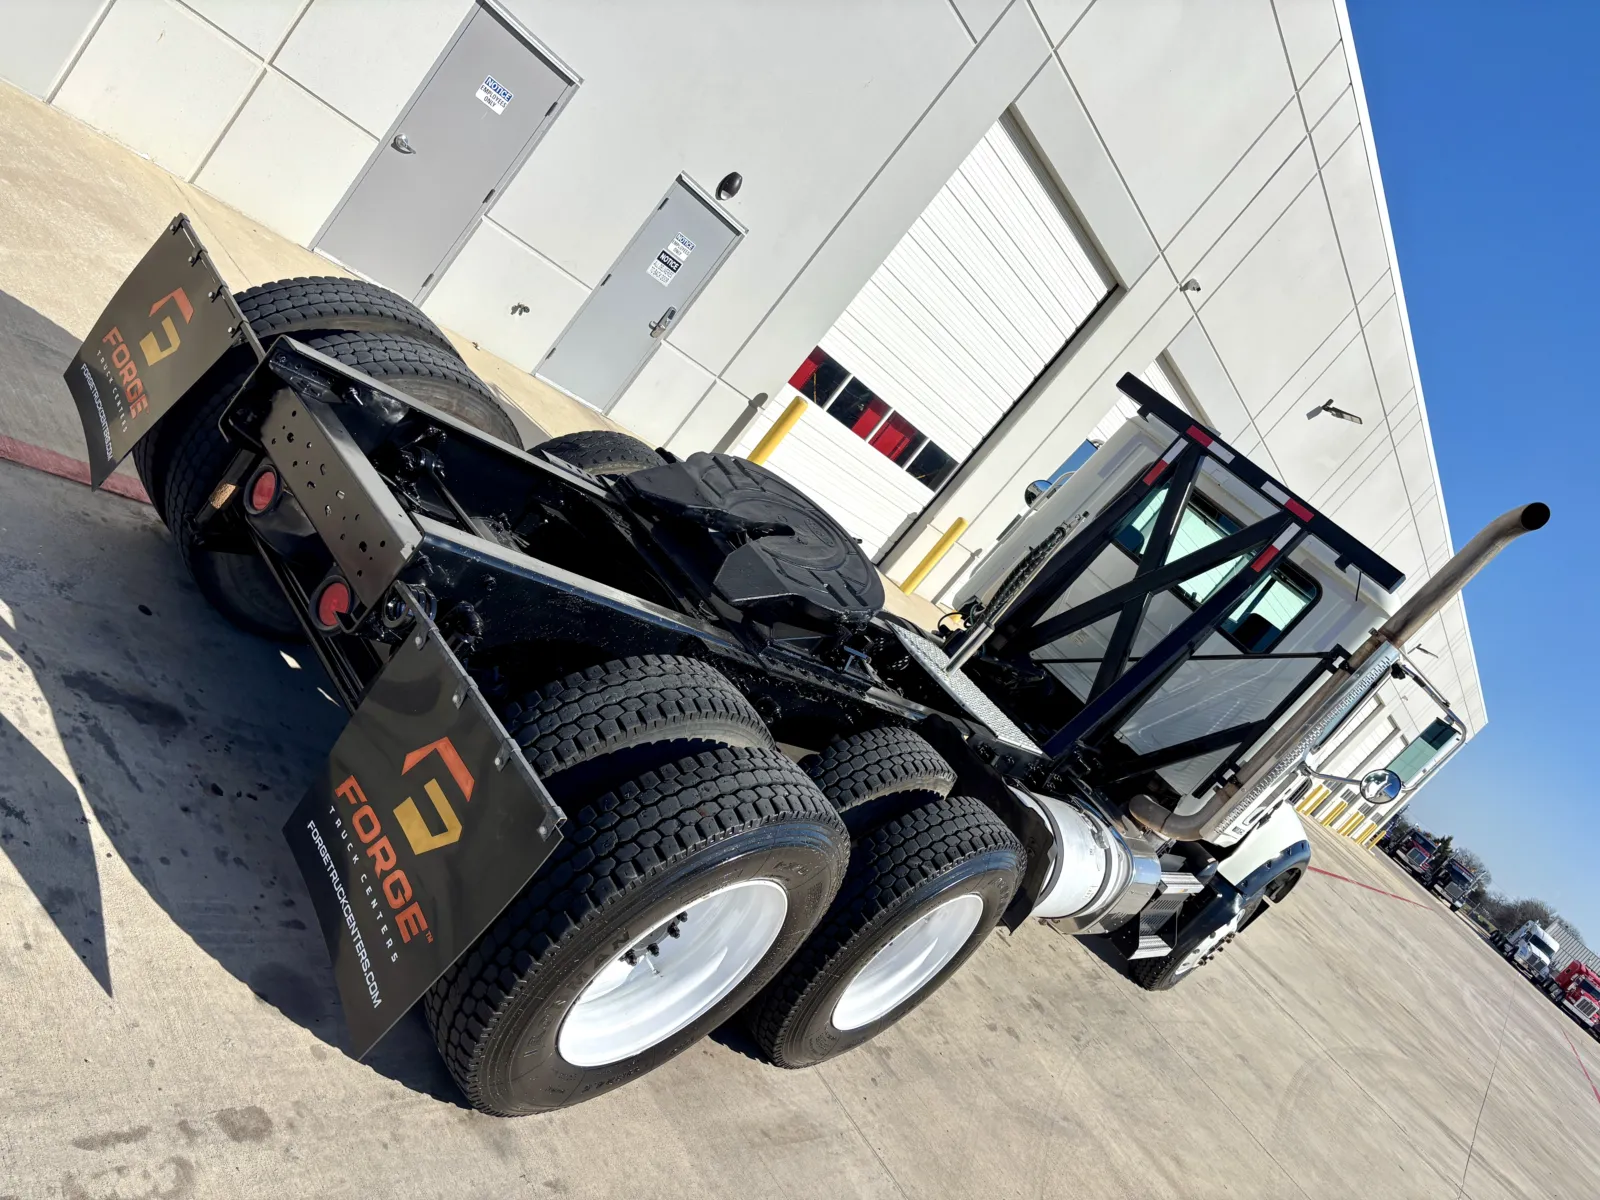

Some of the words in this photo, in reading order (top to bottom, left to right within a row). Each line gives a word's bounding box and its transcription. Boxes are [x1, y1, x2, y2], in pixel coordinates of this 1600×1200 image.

[480, 84, 507, 108] EMPLOYEES
[484, 95, 497, 108] ONLY
[486, 77, 512, 101] NOTICE
[659, 252, 680, 271] NOTICE
[676, 233, 695, 250] NOTICE
[80, 363, 113, 461] FORGETRUCKCENTERS.COM
[96, 349, 113, 384] TRUCK
[112, 387, 128, 433] CENTERS
[102, 326, 148, 420] FORGE
[329, 805, 360, 864] TRUCK
[360, 874, 398, 963] CENTERS
[334, 775, 428, 944] FORGE
[307, 820, 382, 1009] FORGETRUCKCENTERS.COM
